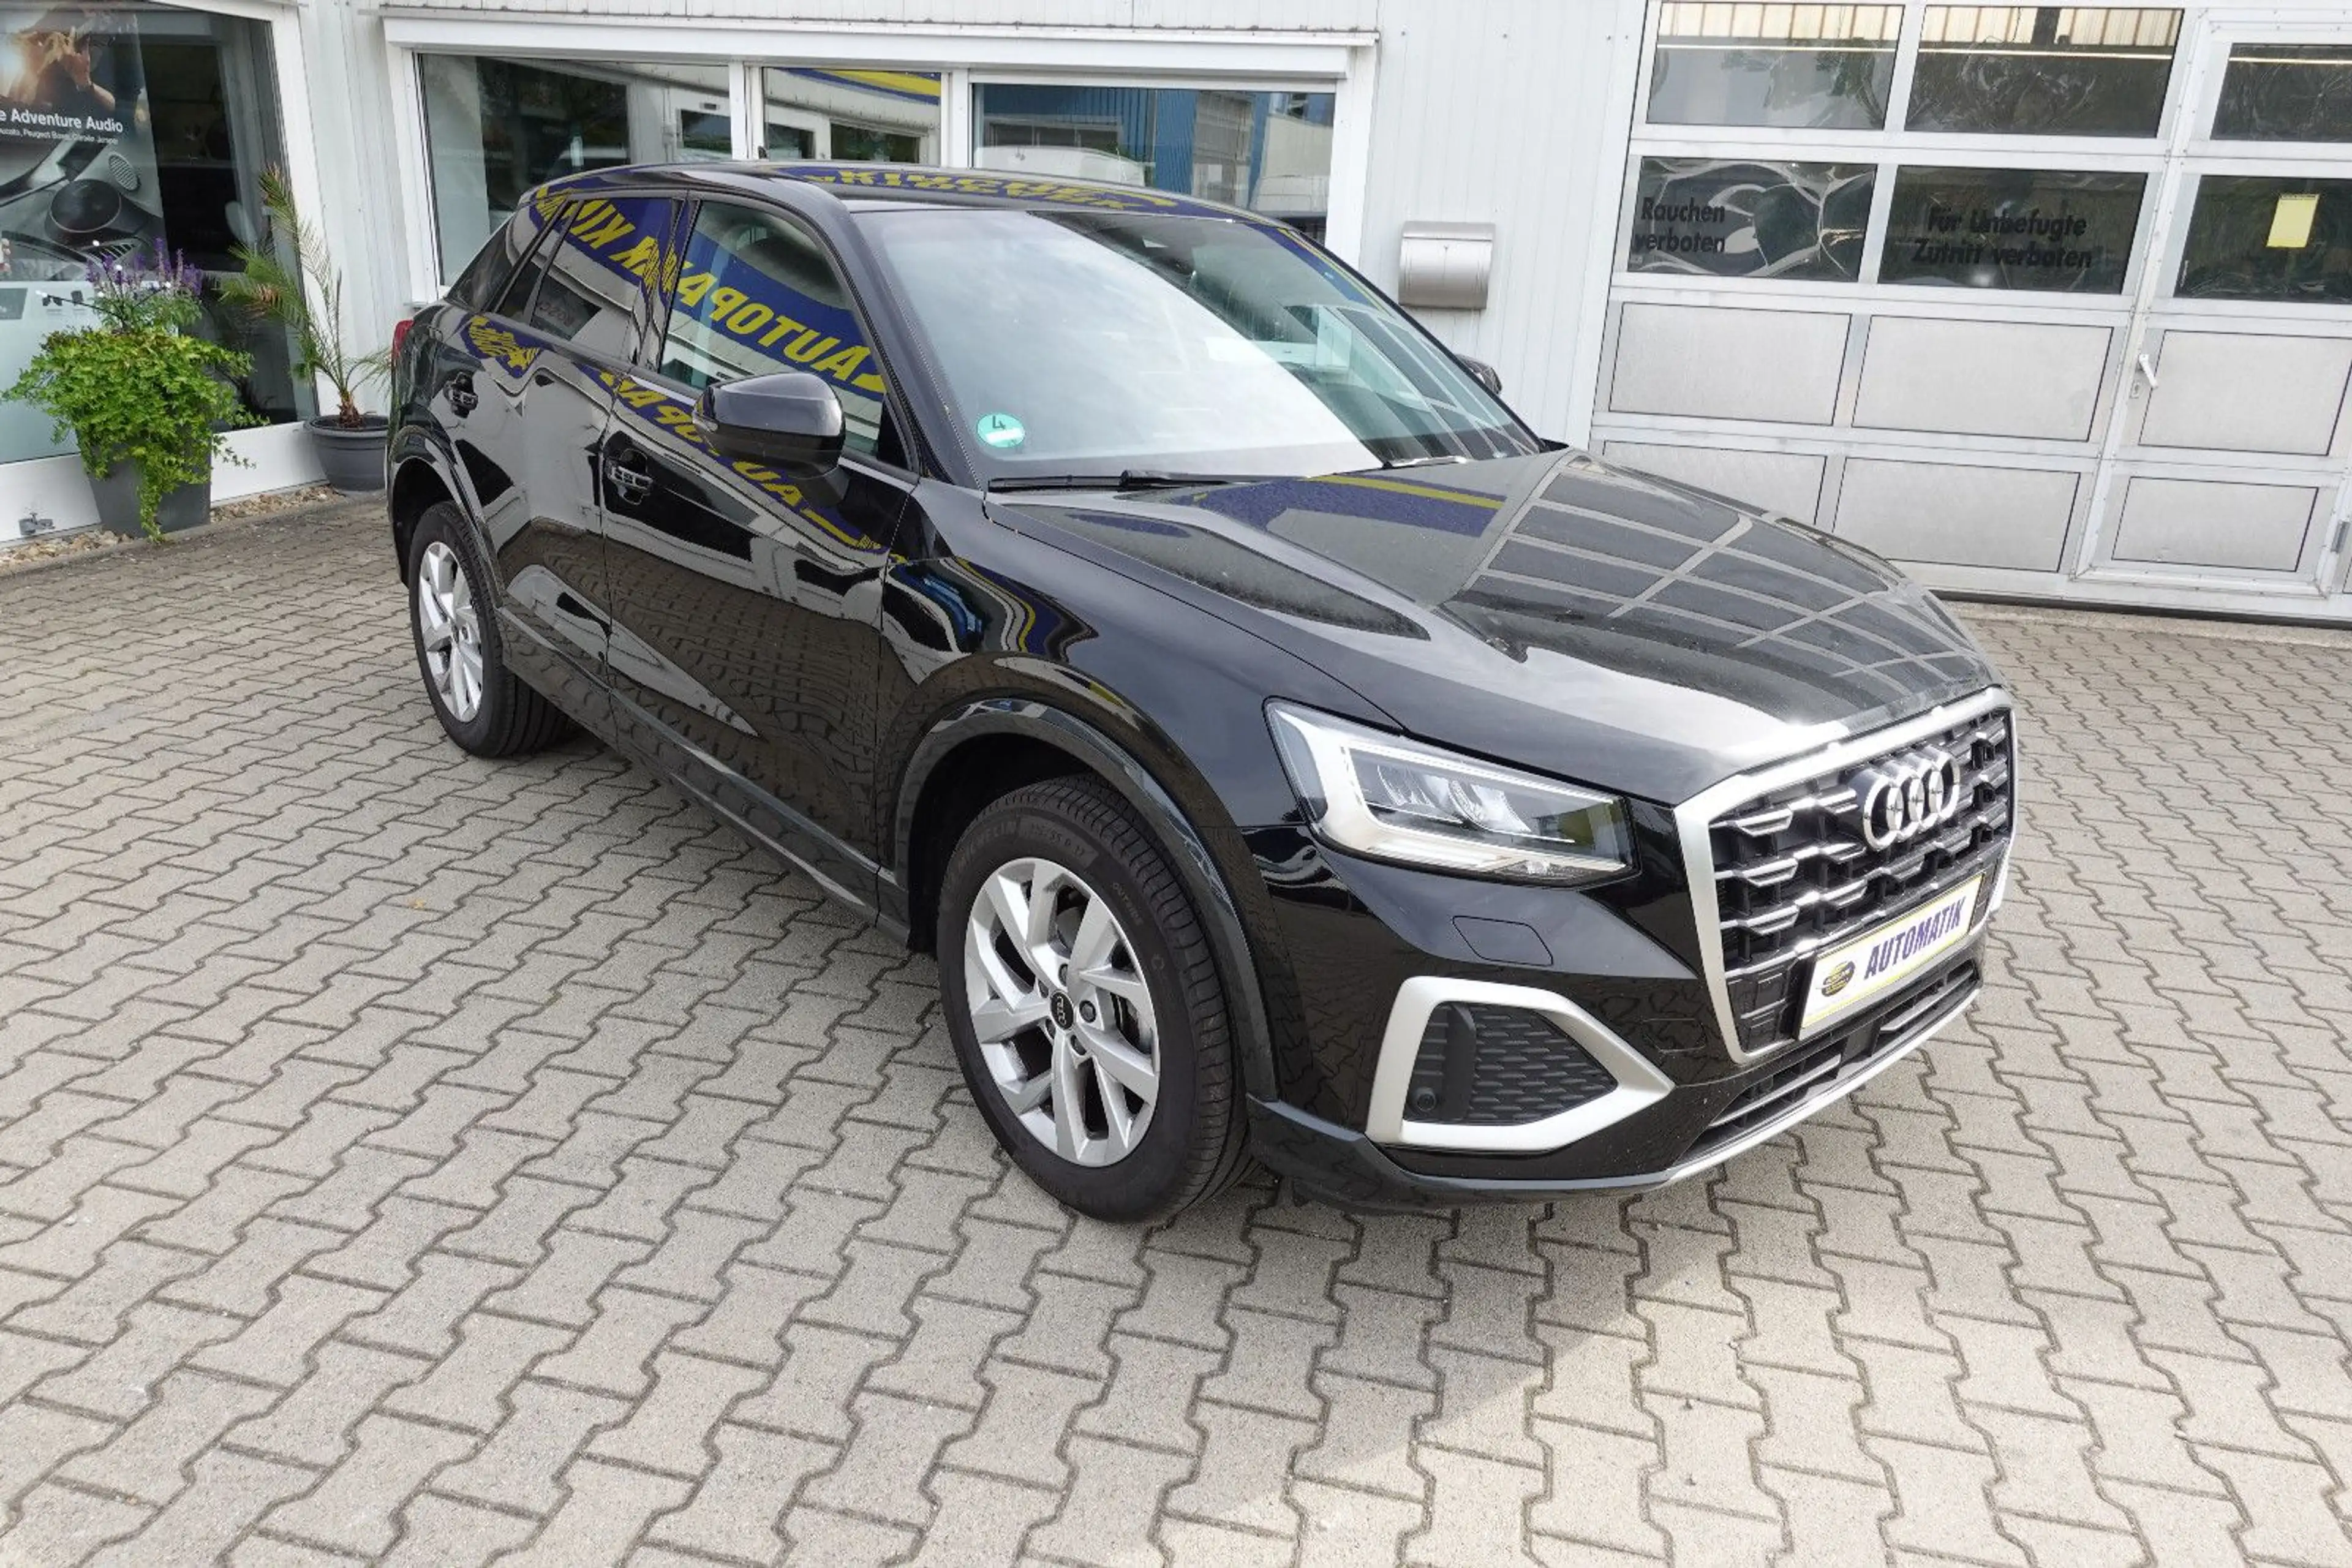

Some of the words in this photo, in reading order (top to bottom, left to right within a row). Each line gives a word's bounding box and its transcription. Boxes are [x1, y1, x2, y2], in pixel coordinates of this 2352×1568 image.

[11, 108, 82, 129] Adventure
[86, 116, 123, 133] Audio
[1641, 197, 1725, 224] Rauchen
[1929, 206, 1961, 232] Für
[1970, 208, 2087, 241] Unbefugte
[1632, 228, 1725, 254] verboten
[1912, 238, 1985, 264] Zutritt
[1992, 241, 2092, 268] verboten
[993, 416, 1006, 429] 4
[1864, 895, 1966, 980] AUTOMATIK
